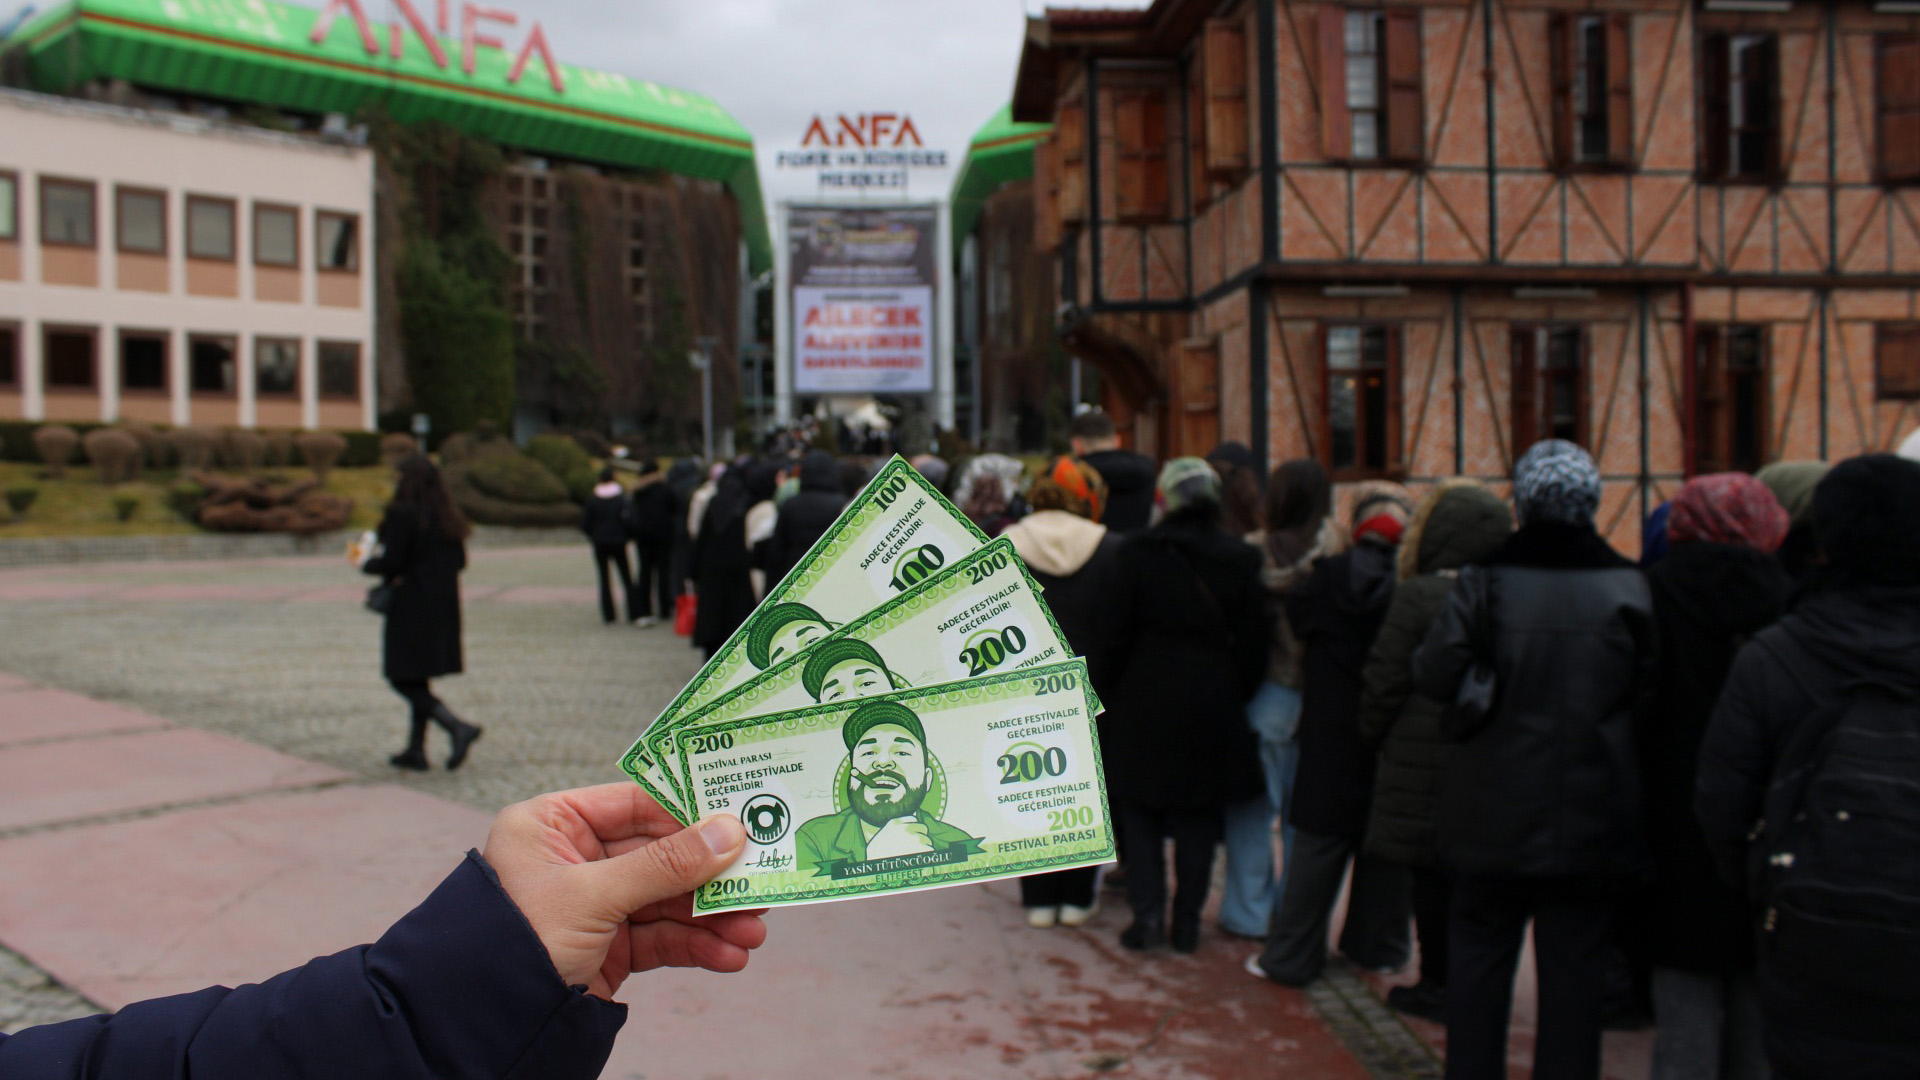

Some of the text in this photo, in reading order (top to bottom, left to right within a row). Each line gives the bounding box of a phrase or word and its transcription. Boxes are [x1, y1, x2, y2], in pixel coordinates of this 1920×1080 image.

[310, 0, 565, 93] ANFA
[801, 114, 923, 148] ANFA
[872, 476, 907, 513] 100
[860, 497, 927, 571] SADECE FESTİVALDE
[881, 518, 924, 565] GEÇERLİDİR!
[888, 543, 945, 592] 100
[966, 552, 1008, 585] 200
[937, 581, 1021, 633] SADECE FESTİVALDE
[959, 600, 1012, 635] GEÇERLİDİR!
[958, 625, 1027, 677] 200
[1033, 673, 1077, 696] 200
[987, 707, 1080, 731] SADECE FESTİVALDE
[1007, 723, 1065, 739] GEÇERLİDİR!
[691, 732, 734, 755] 200
[698, 752, 772, 772] FESTİVAL PARASI
[996, 747, 1067, 785] 200
[703, 762, 804, 787] SADECE FESTİVALDE
[704, 780, 764, 797] GEÇERLİDİR!
[997, 781, 1091, 804] SADECE FESTİVALDE
[707, 798, 730, 810] S35
[1017, 796, 1076, 813] GEÇERLİDİR!
[1047, 805, 1094, 832] 200
[998, 829, 1097, 853] FESTİVAL PARASI
[843, 852, 953, 876] YASİN TÜTÜNCÜOĞLU
[875, 868, 924, 884] ELITEFEST
[710, 877, 750, 897] 200
